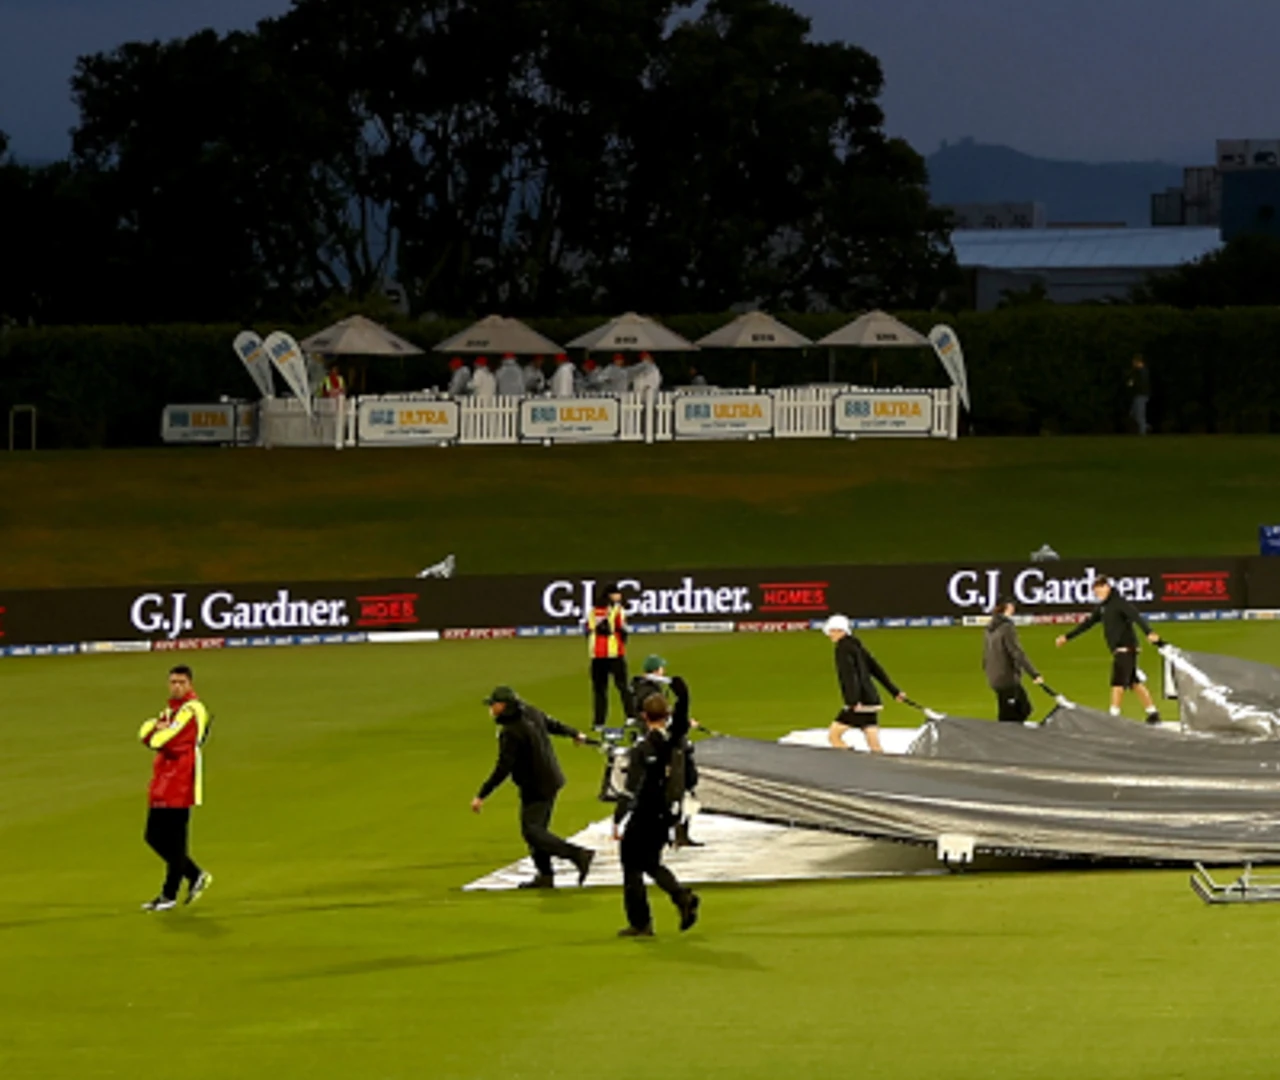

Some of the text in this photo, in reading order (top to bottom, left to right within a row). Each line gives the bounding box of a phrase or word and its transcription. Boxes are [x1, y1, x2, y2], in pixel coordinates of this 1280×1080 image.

[399, 409, 448, 425] ULTRA
[560, 406, 608, 421] ULTRA
[713, 403, 762, 418] ULTRA
[874, 401, 921, 417] ULTRA
[948, 566, 1227, 613] G.J Garder. HOMES
[542, 580, 597, 624] G.J
[763, 589, 825, 604] HOMES
[131, 593, 194, 638] G.J.
[201, 590, 349, 629] Gardner.
